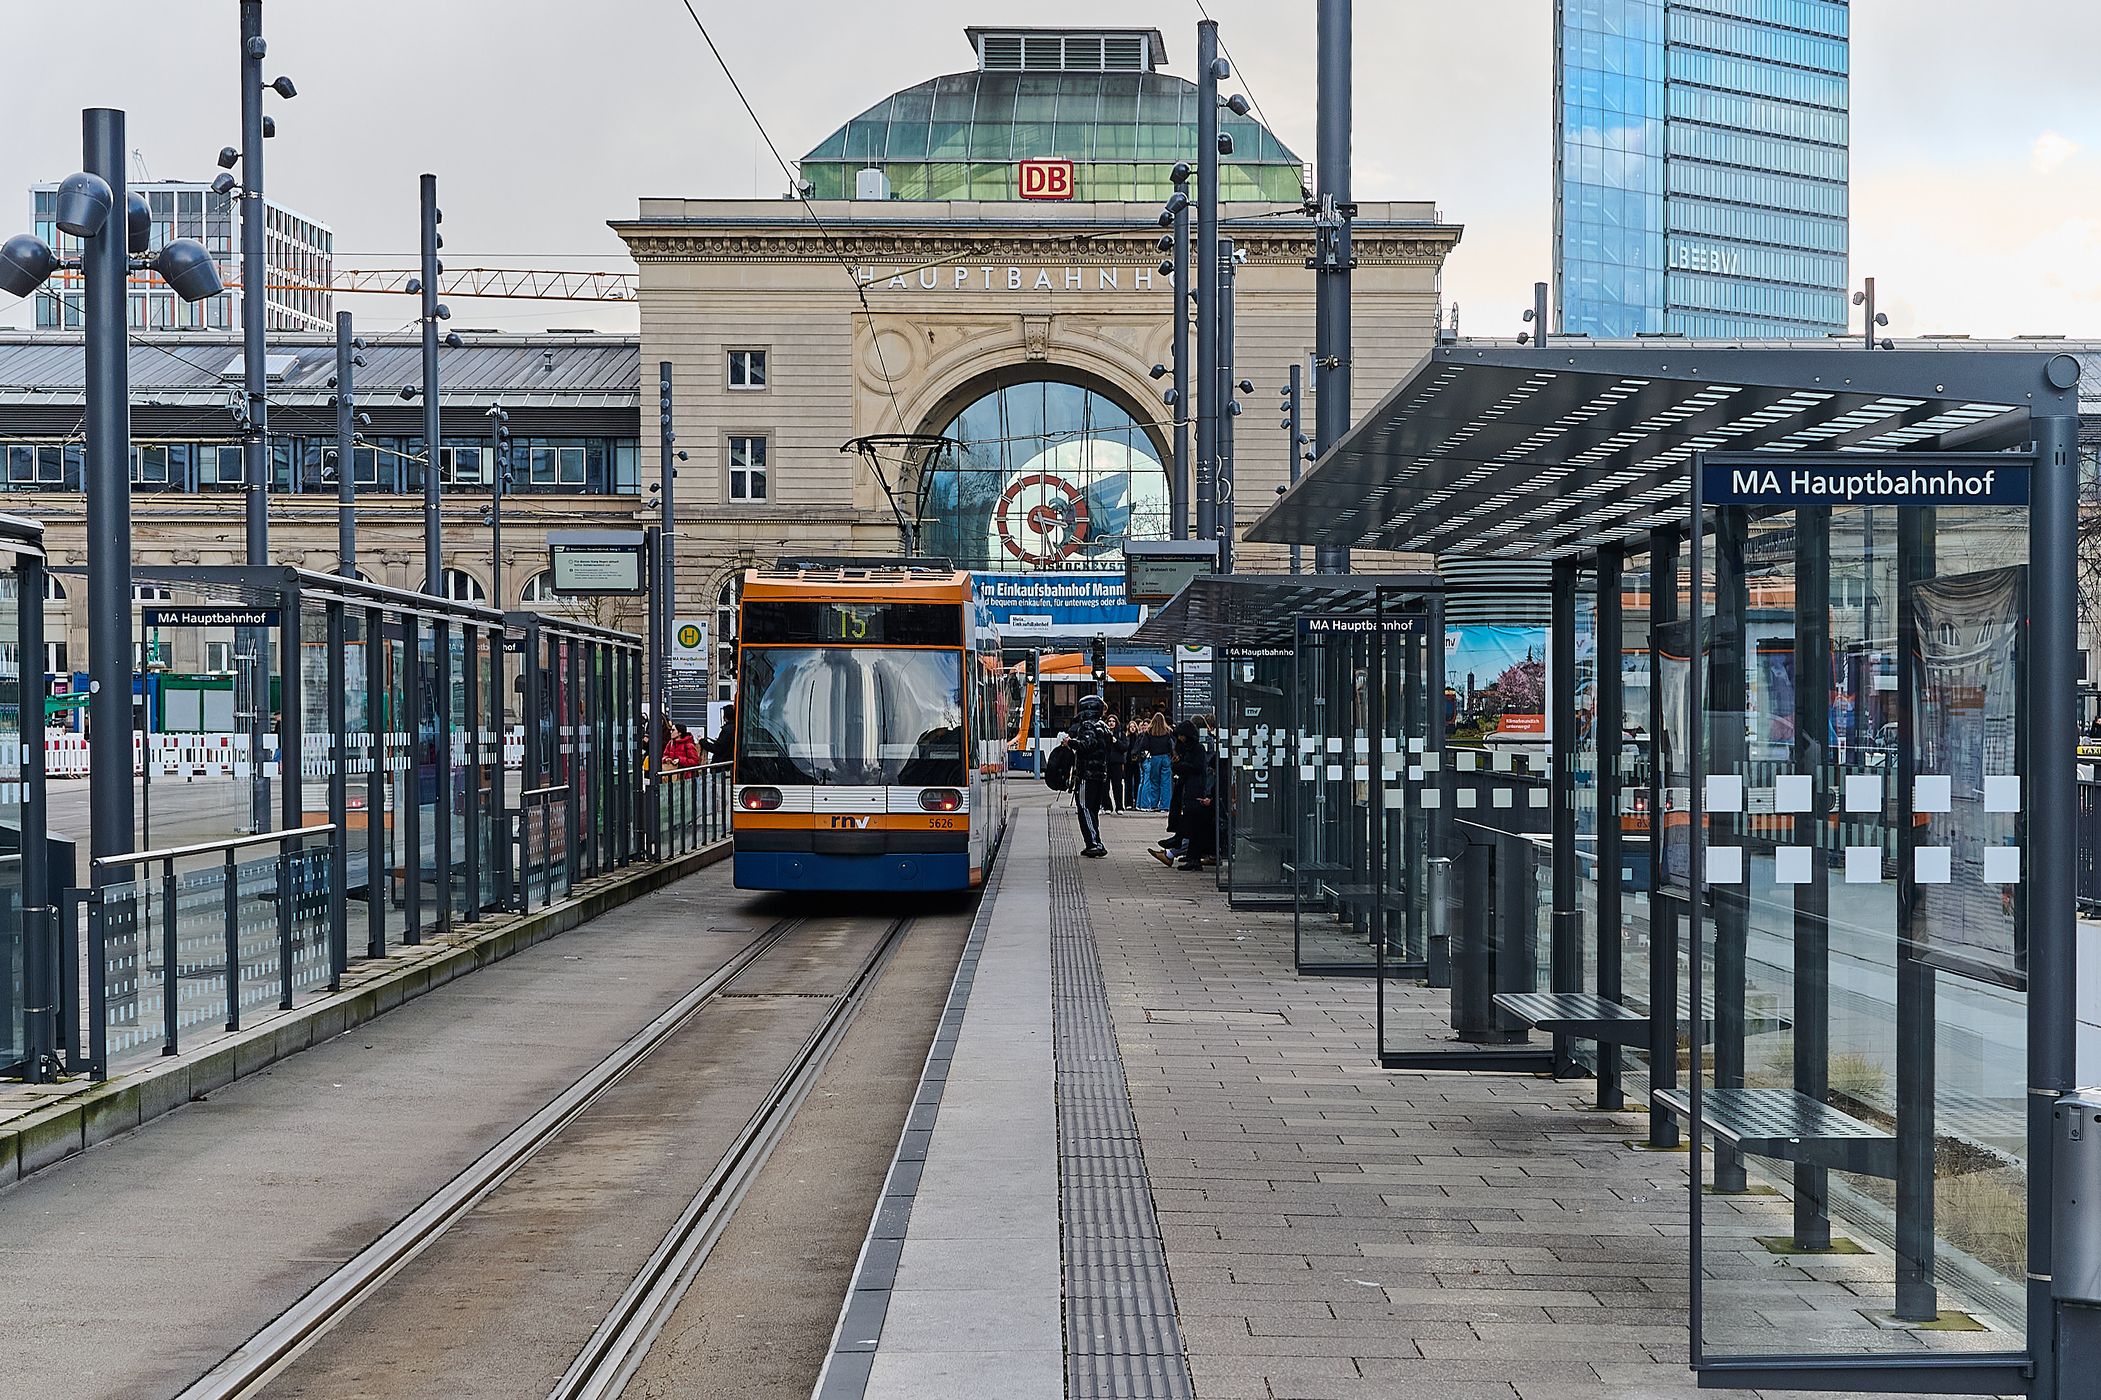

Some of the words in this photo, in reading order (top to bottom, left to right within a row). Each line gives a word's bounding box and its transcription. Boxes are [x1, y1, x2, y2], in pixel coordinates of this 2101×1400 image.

[1026, 166, 1067, 192] DB
[859, 266, 1174, 290] HAUPTBAHNH
[1732, 470, 1781, 494] MA
[1791, 470, 1995, 500] Hauptbahnhof
[981, 582, 994, 596] im
[997, 582, 1090, 597] Einkaufsbahnhof
[990, 599, 1017, 608] bequem
[1018, 599, 1052, 608] einkaufen,
[1053, 599, 1063, 607] für
[1064, 599, 1099, 608] unterwegs
[1116, 598, 1126, 606] da
[158, 613, 178, 623] MA
[182, 612, 266, 625] Hauptbahnhof
[1310, 620, 1329, 630] MA
[1333, 620, 1413, 632] Hauptbanhof
[1250, 723, 1269, 803] Tickts
[831, 815, 870, 829] rnv
[929, 818, 953, 829] 5626
